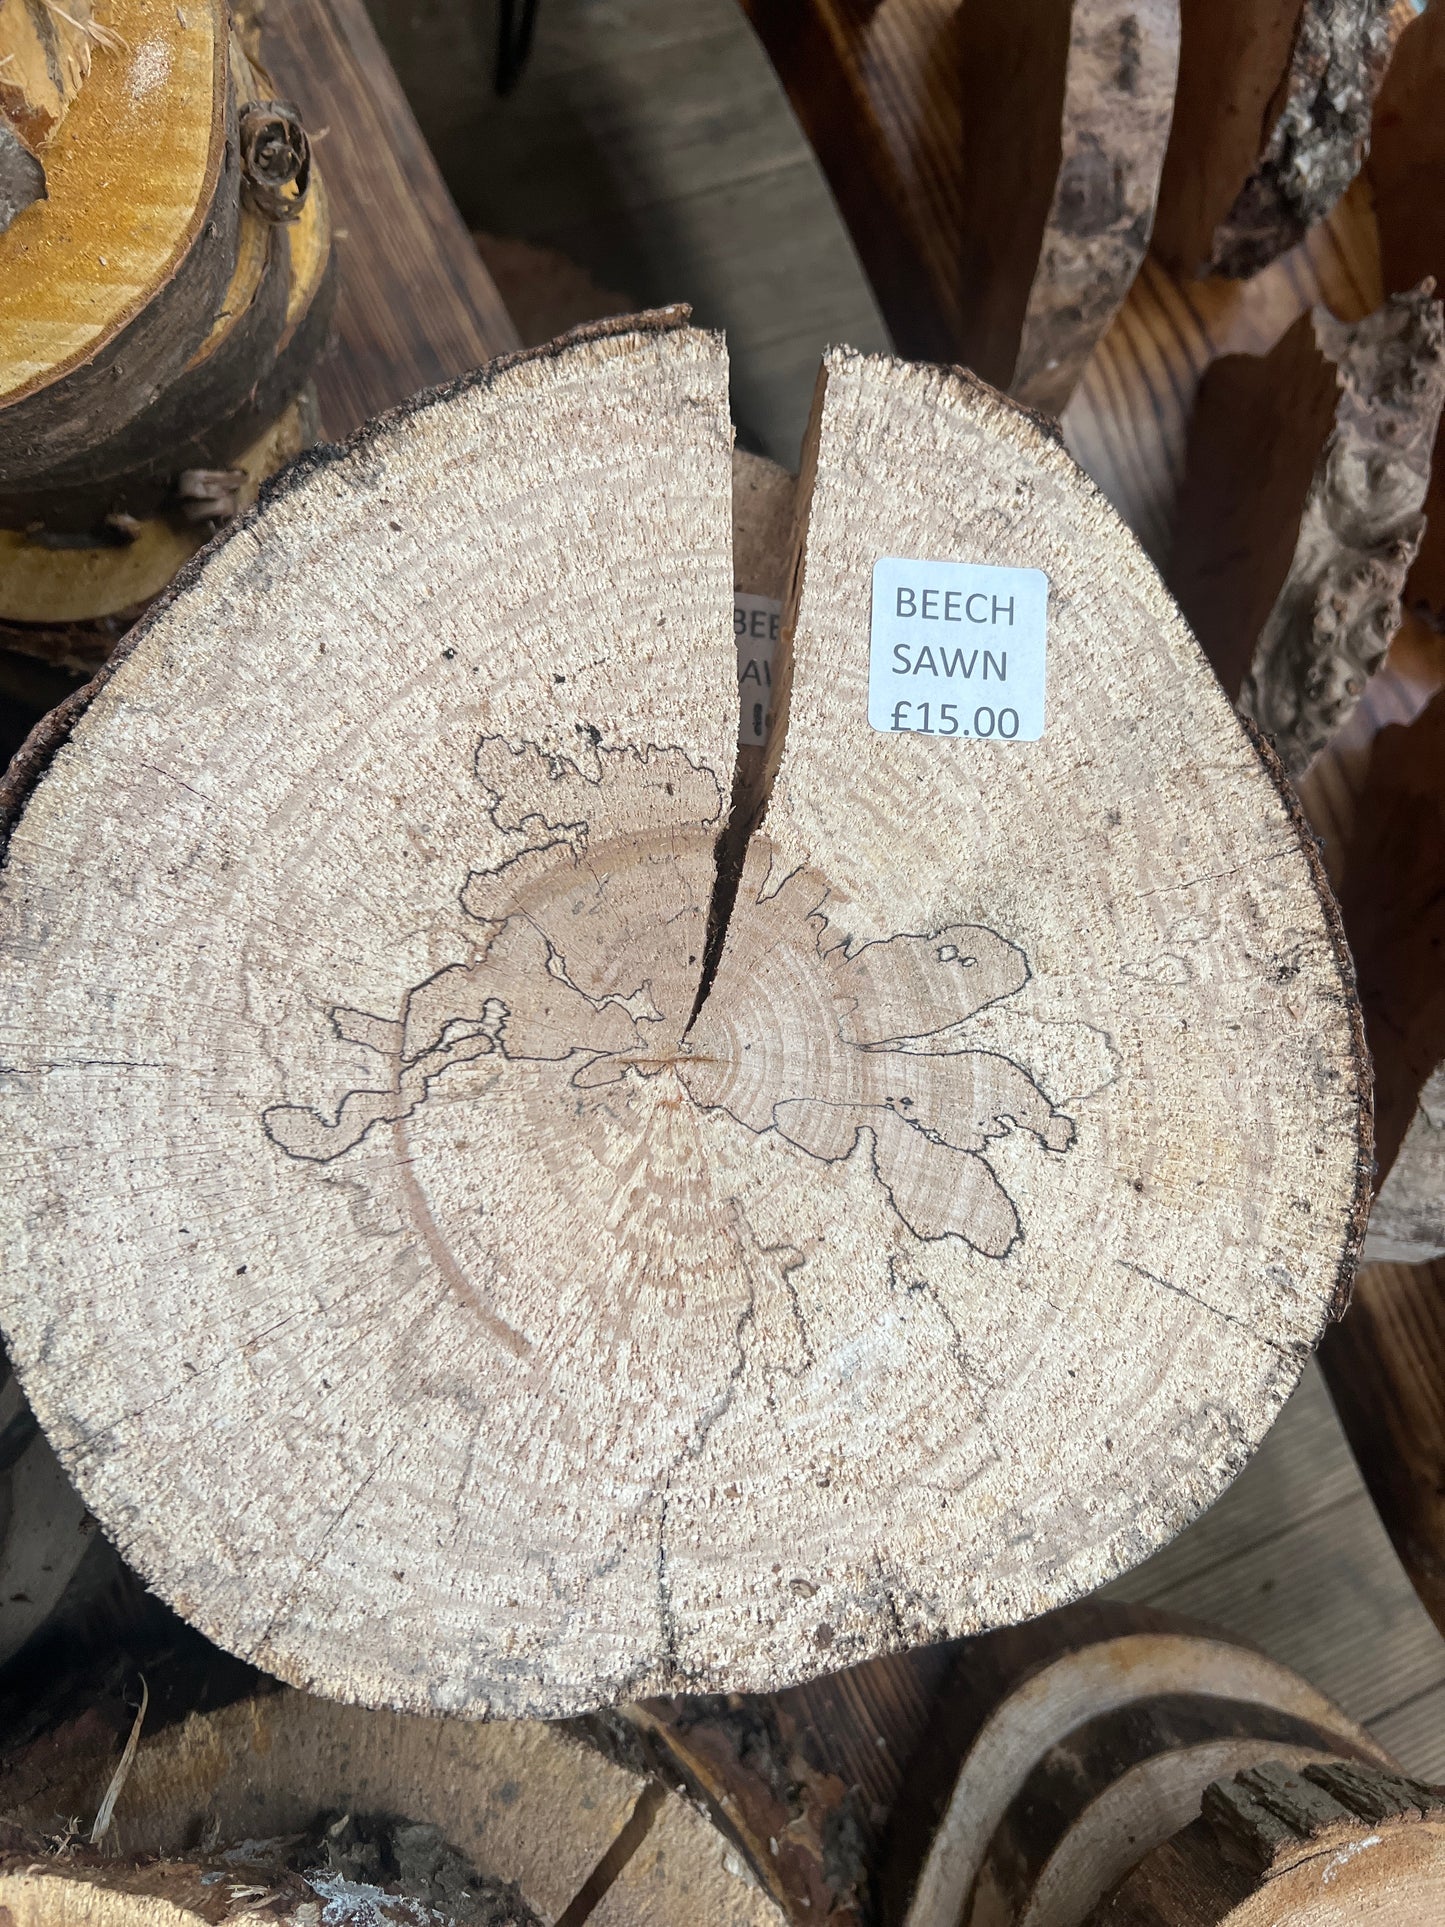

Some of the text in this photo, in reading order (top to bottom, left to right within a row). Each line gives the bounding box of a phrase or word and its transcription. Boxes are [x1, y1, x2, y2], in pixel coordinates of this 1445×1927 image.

[896, 587, 1014, 626] BEECH
[892, 643, 1007, 682] SAWN
[890, 701, 1020, 739] £15.00
